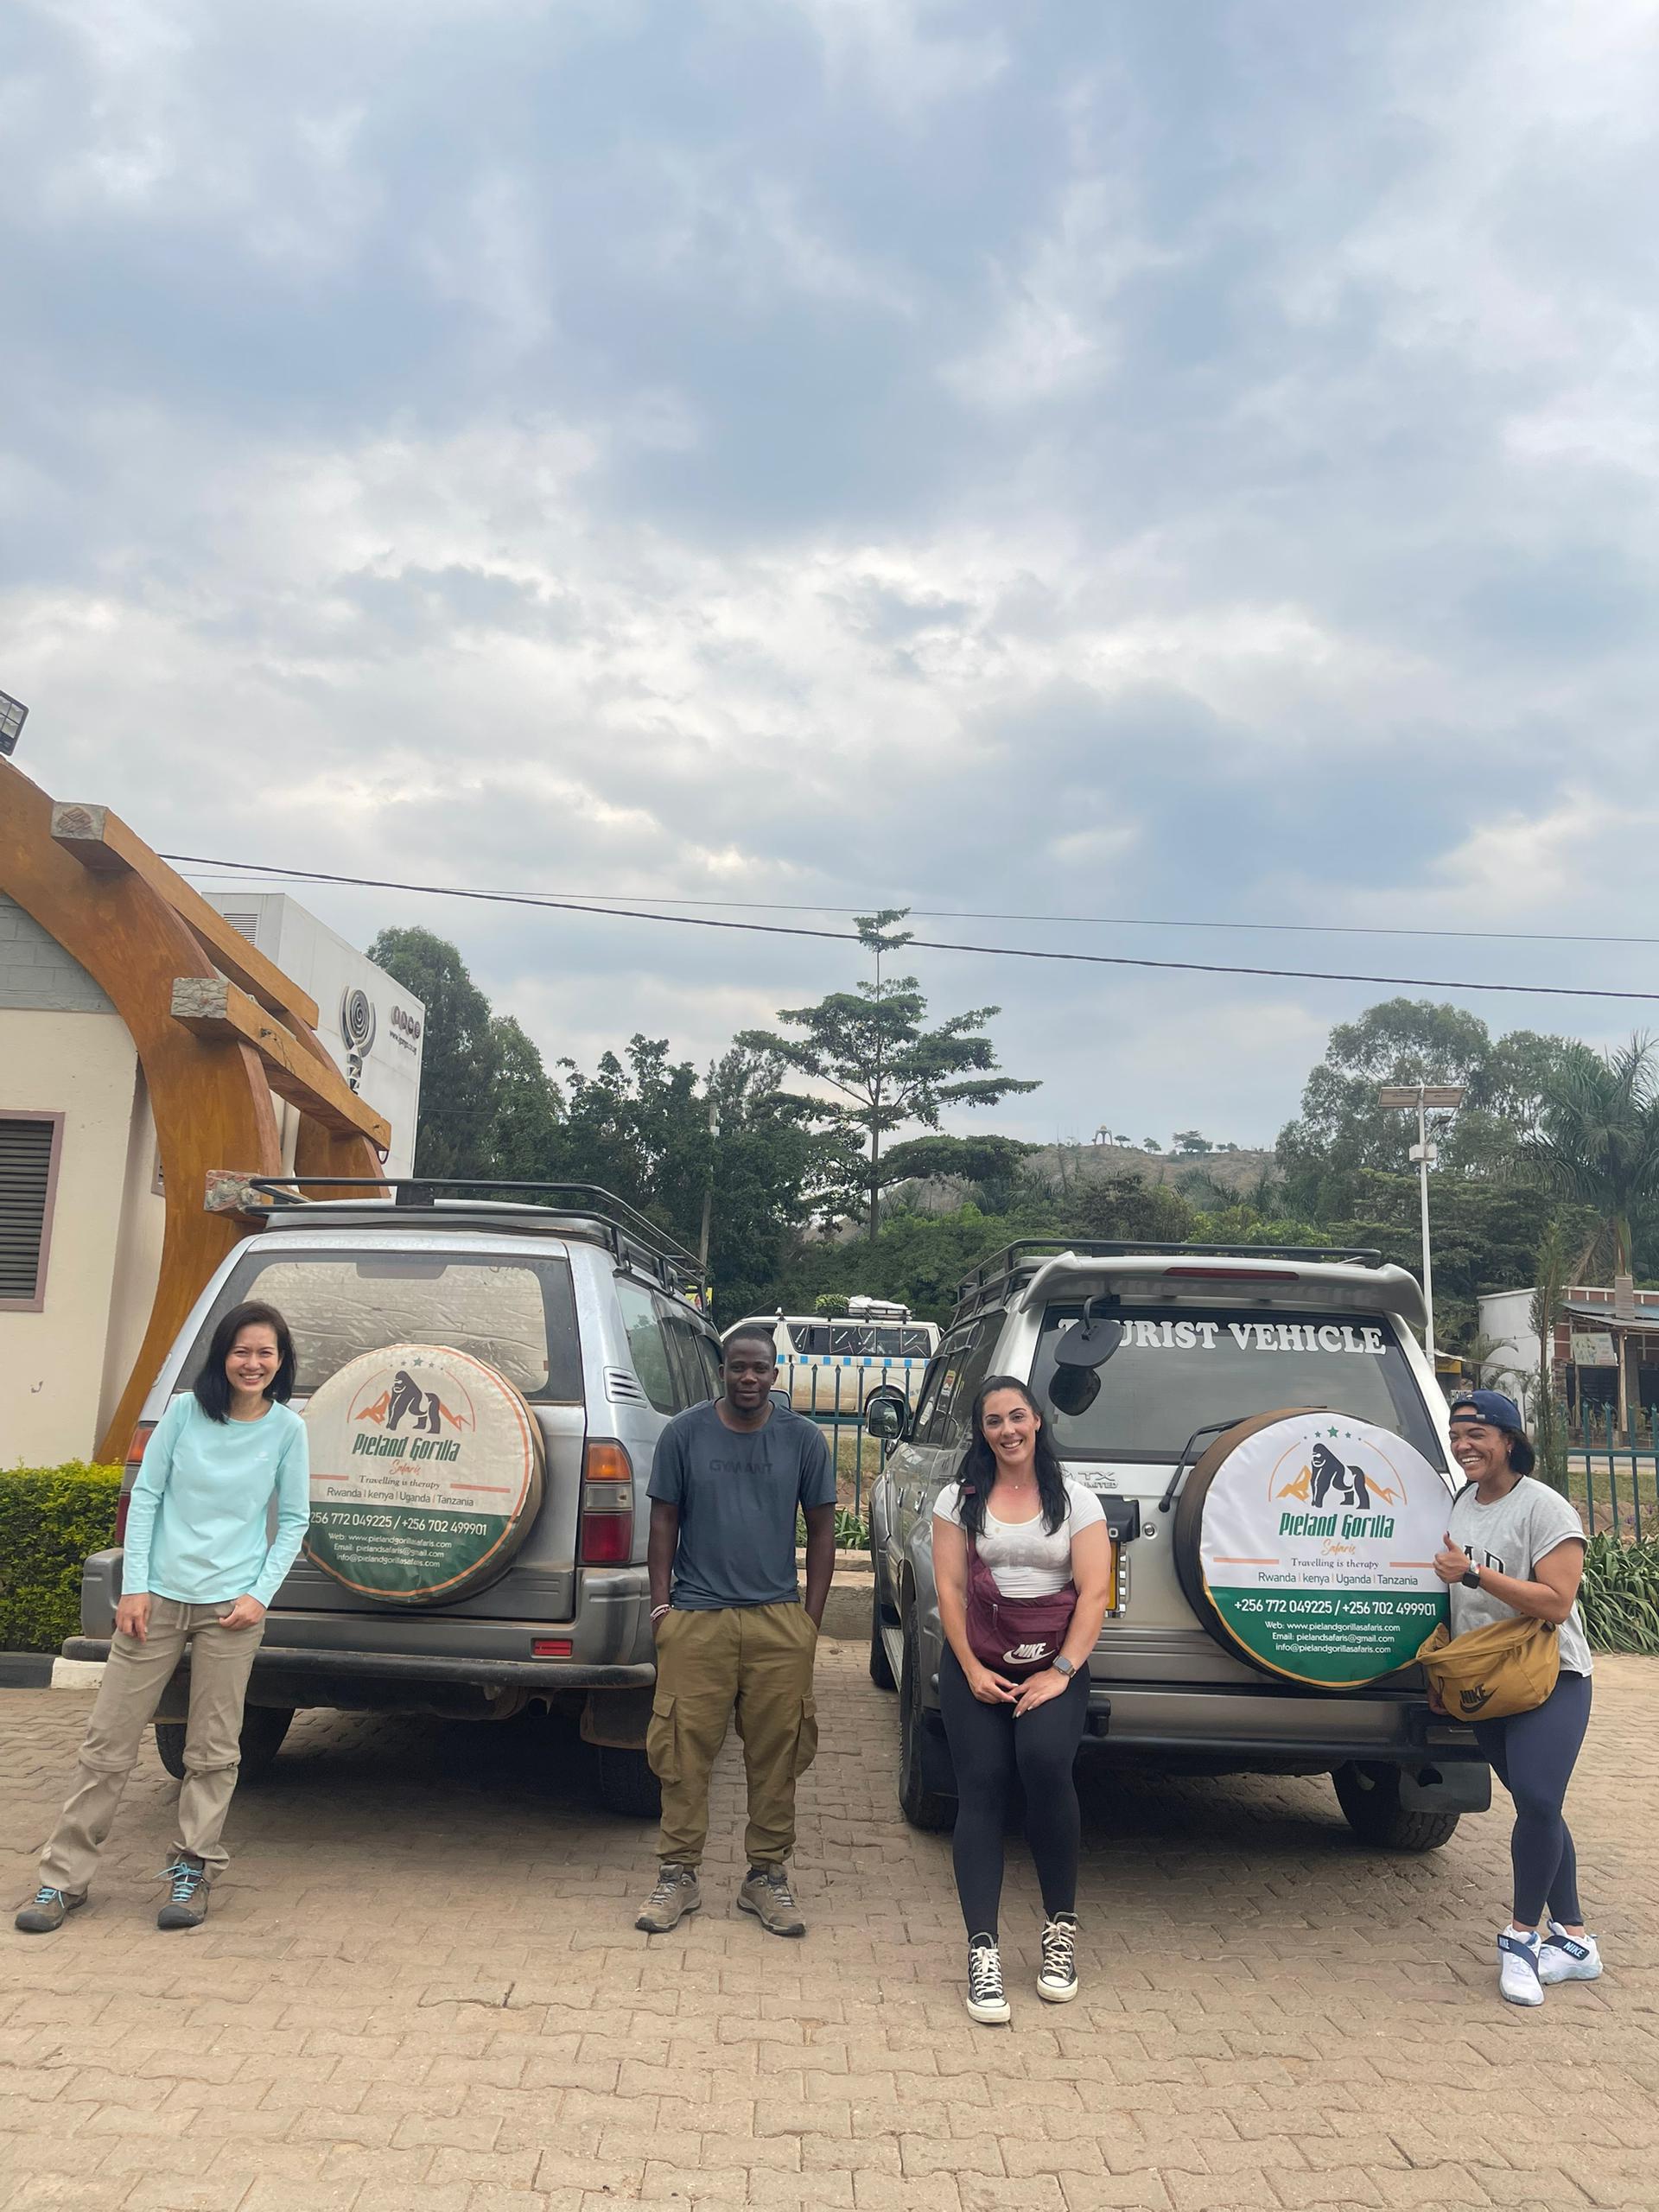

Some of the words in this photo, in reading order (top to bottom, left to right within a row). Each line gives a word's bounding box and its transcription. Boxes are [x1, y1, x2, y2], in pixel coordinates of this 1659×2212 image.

[1228, 1323, 1386, 1355] VEHICLE
[410, 1438, 461, 1462] Gorilla
[389, 1459, 422, 1476] Safaris
[1077, 1471, 1116, 1481] TX
[359, 1474, 399, 1487] Travelling
[402, 1478, 408, 1486] is
[410, 1478, 441, 1491] therapy
[327, 1487, 362, 1498] Rwanda
[368, 1490, 394, 1503] kenya
[399, 1491, 430, 1504] Uganda
[437, 1495, 474, 1507] Tanzania
[331, 1512, 351, 1525] 772
[353, 1514, 392, 1528] 049225
[402, 1518, 425, 1531] +256
[428, 1520, 449, 1533] 702
[450, 1522, 487, 1536] 499901
[1341, 1514, 1395, 1540] Gorilla
[1320, 1538, 1356, 1556] Safaris
[1291, 1557, 1334, 1569] Travelling
[1337, 1560, 1344, 1568] is
[1346, 1560, 1379, 1570] therapy
[1258, 1572, 1296, 1583] Rwanda
[1303, 1573, 1330, 1586] kenya
[1336, 1573, 1371, 1586] Uganda
[1377, 1574, 1418, 1586] Tanzania
[1234, 1599, 1263, 1612] +256
[1266, 1599, 1287, 1613] 772
[1289, 1599, 1332, 1614] 049225
[1342, 1601, 1371, 1615] +256
[1373, 1601, 1394, 1615] 702
[1395, 1602, 1436, 1617] 499901
[1265, 1621, 1285, 1630] Web:
[1287, 1622, 1401, 1633] www.pielandgorillasafaris.com
[1272, 1632, 1294, 1641] Email:
[1297, 1633, 1395, 1643] pielandsafaris@gmail.com
[1014, 1643, 1046, 1658] NIKE
[1275, 1643, 1391, 1654] info@pielandgorillasafaris.com
[1459, 1683, 1486, 1703] NIKE
[1563, 1941, 1586, 1958] NIKE
